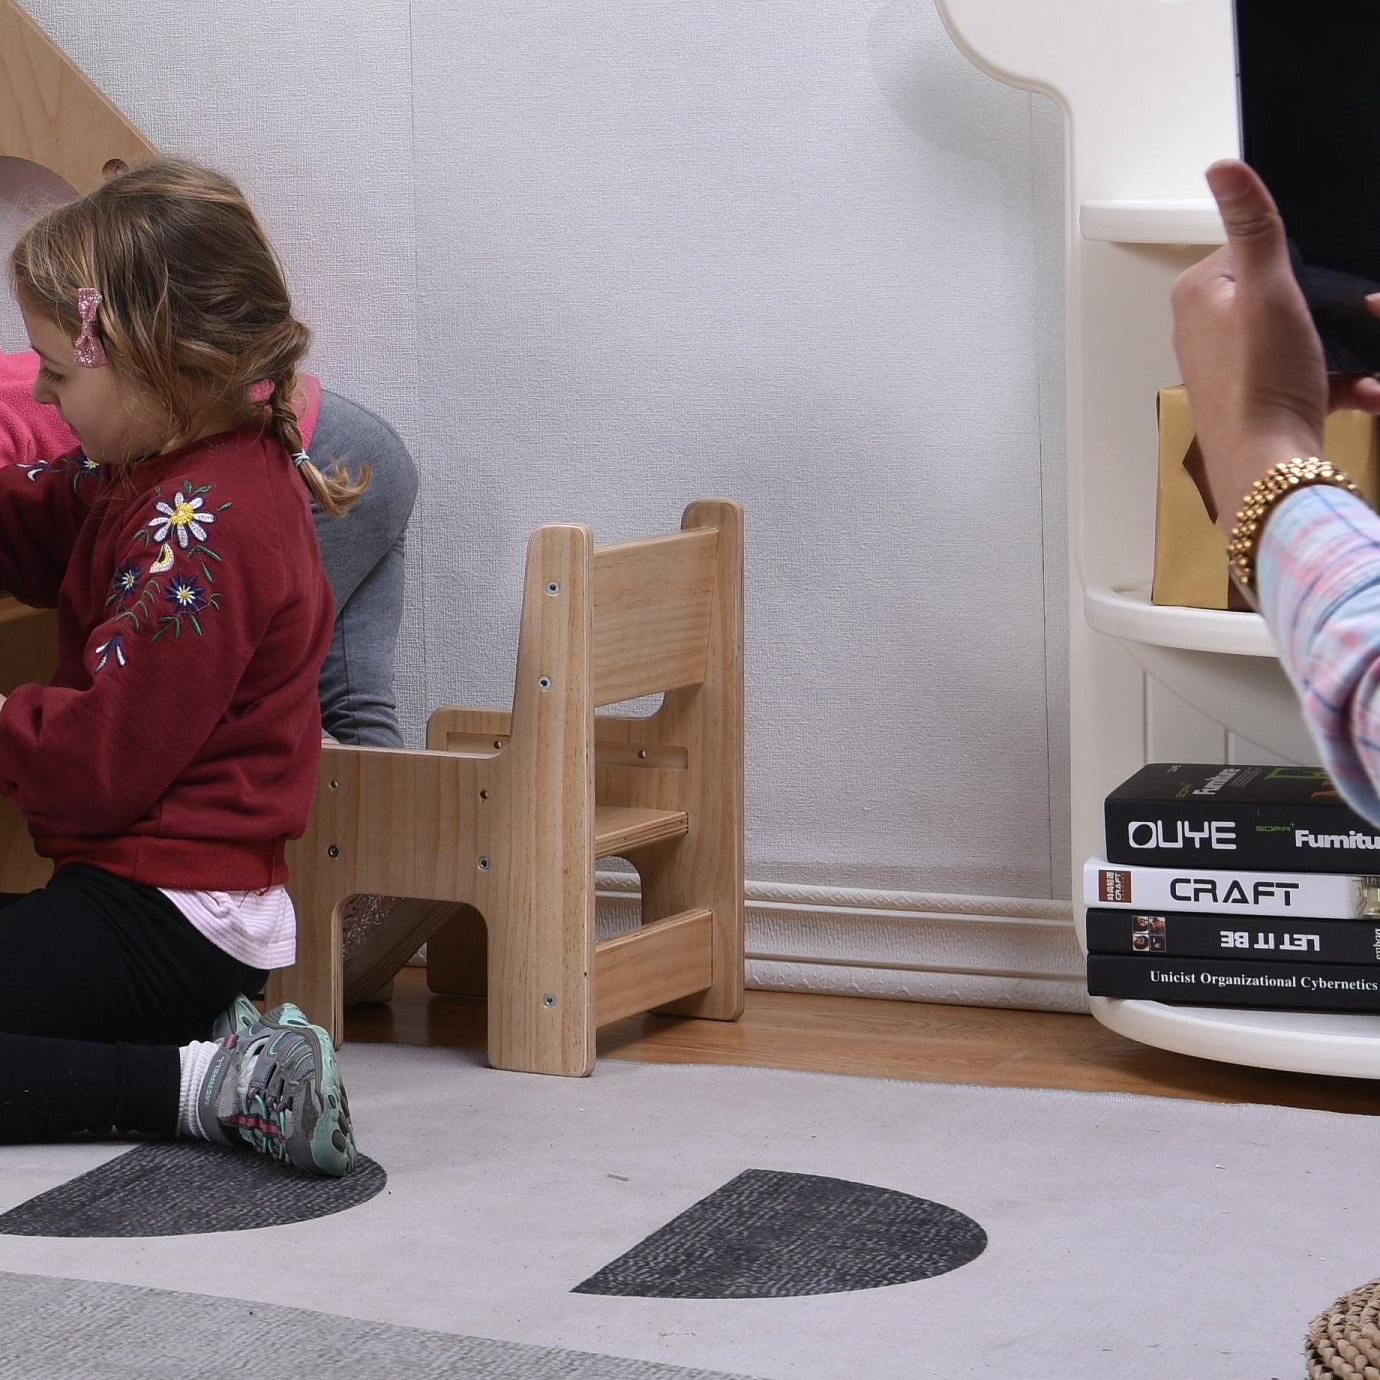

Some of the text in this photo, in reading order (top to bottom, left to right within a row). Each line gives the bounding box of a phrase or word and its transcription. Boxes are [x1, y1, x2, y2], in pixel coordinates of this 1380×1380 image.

[1128, 820, 1237, 850] OUYE
[1170, 878, 1300, 907] CRAFT
[1220, 931, 1320, 951] LET IT BE
[1150, 970, 1378, 990] Unicist Organizational Cybernetics
